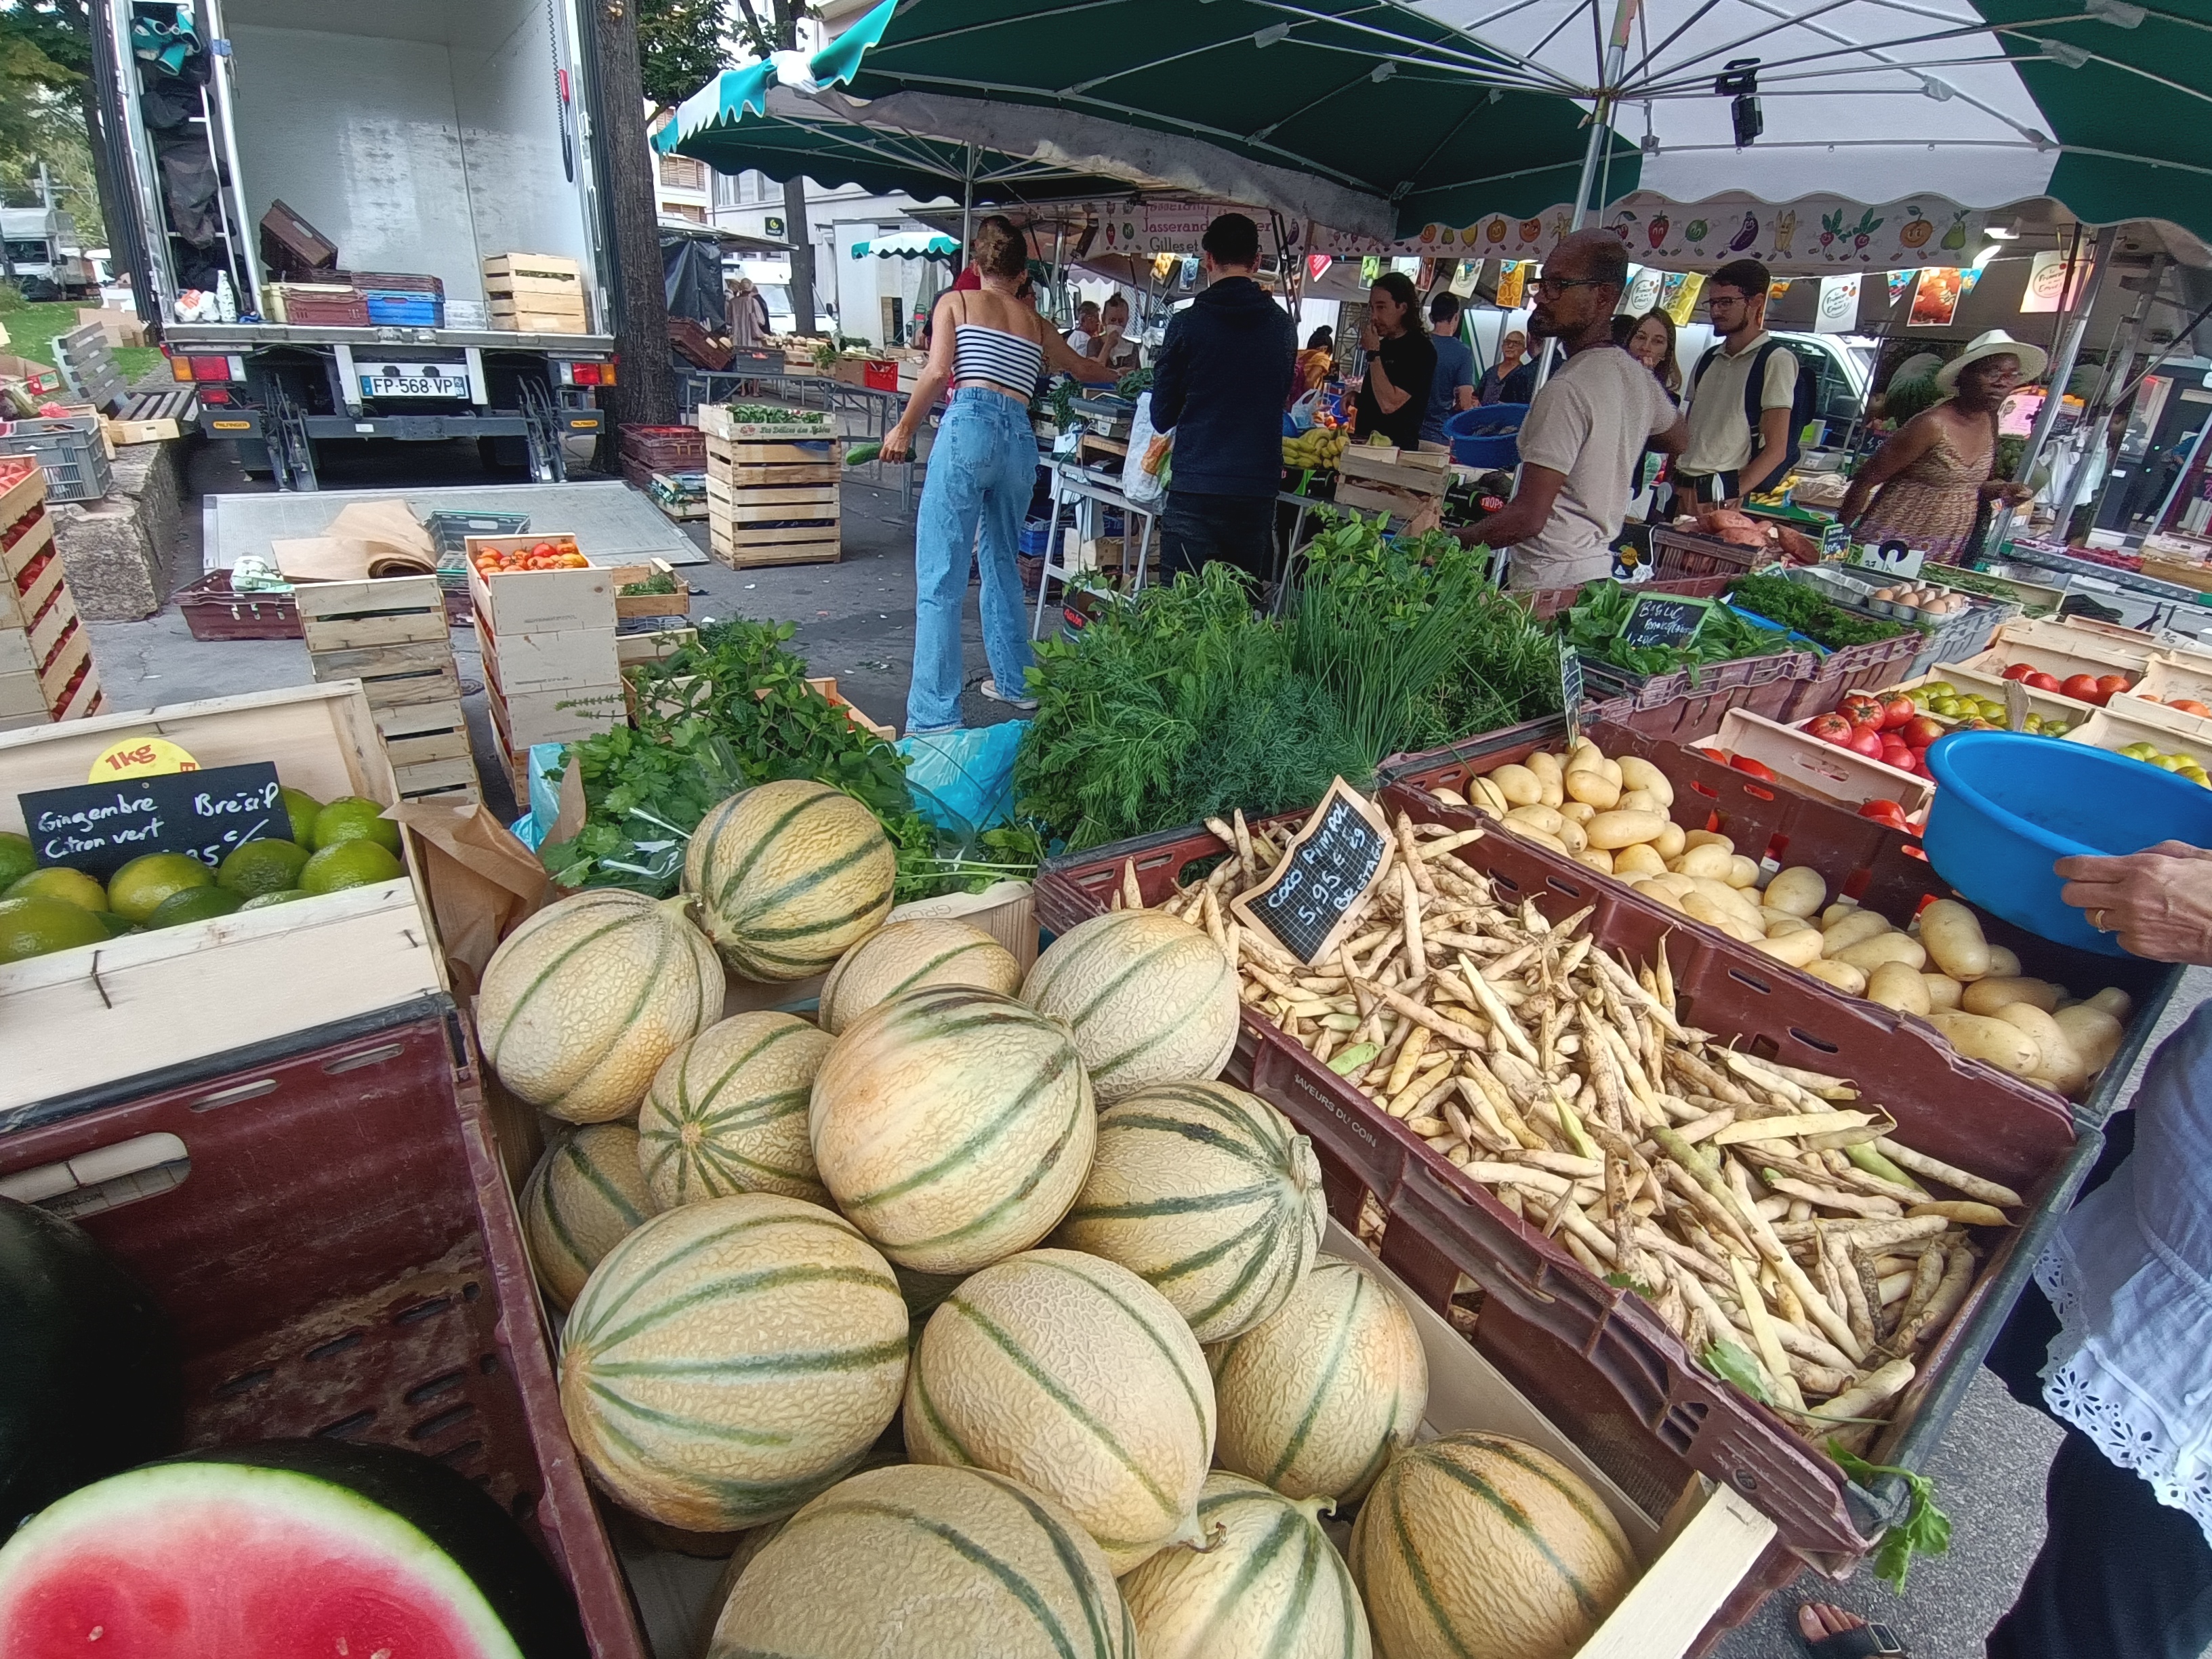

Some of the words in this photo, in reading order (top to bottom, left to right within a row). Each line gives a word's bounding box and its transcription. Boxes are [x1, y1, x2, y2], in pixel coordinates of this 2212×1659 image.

[1142, 216, 1208, 232] Jasserand
[1149, 237, 1185, 251] Gilles
[1187, 239, 1199, 251] et
[105, 744, 156, 771] 1kg
[38, 794, 159, 832] Gingembre
[45, 835, 105, 859] Citron
[112, 817, 165, 844] vert
[1268, 869, 1303, 908] COCO
[1336, 1108, 1351, 1125] DU
[1351, 1122, 1377, 1148] COIN
